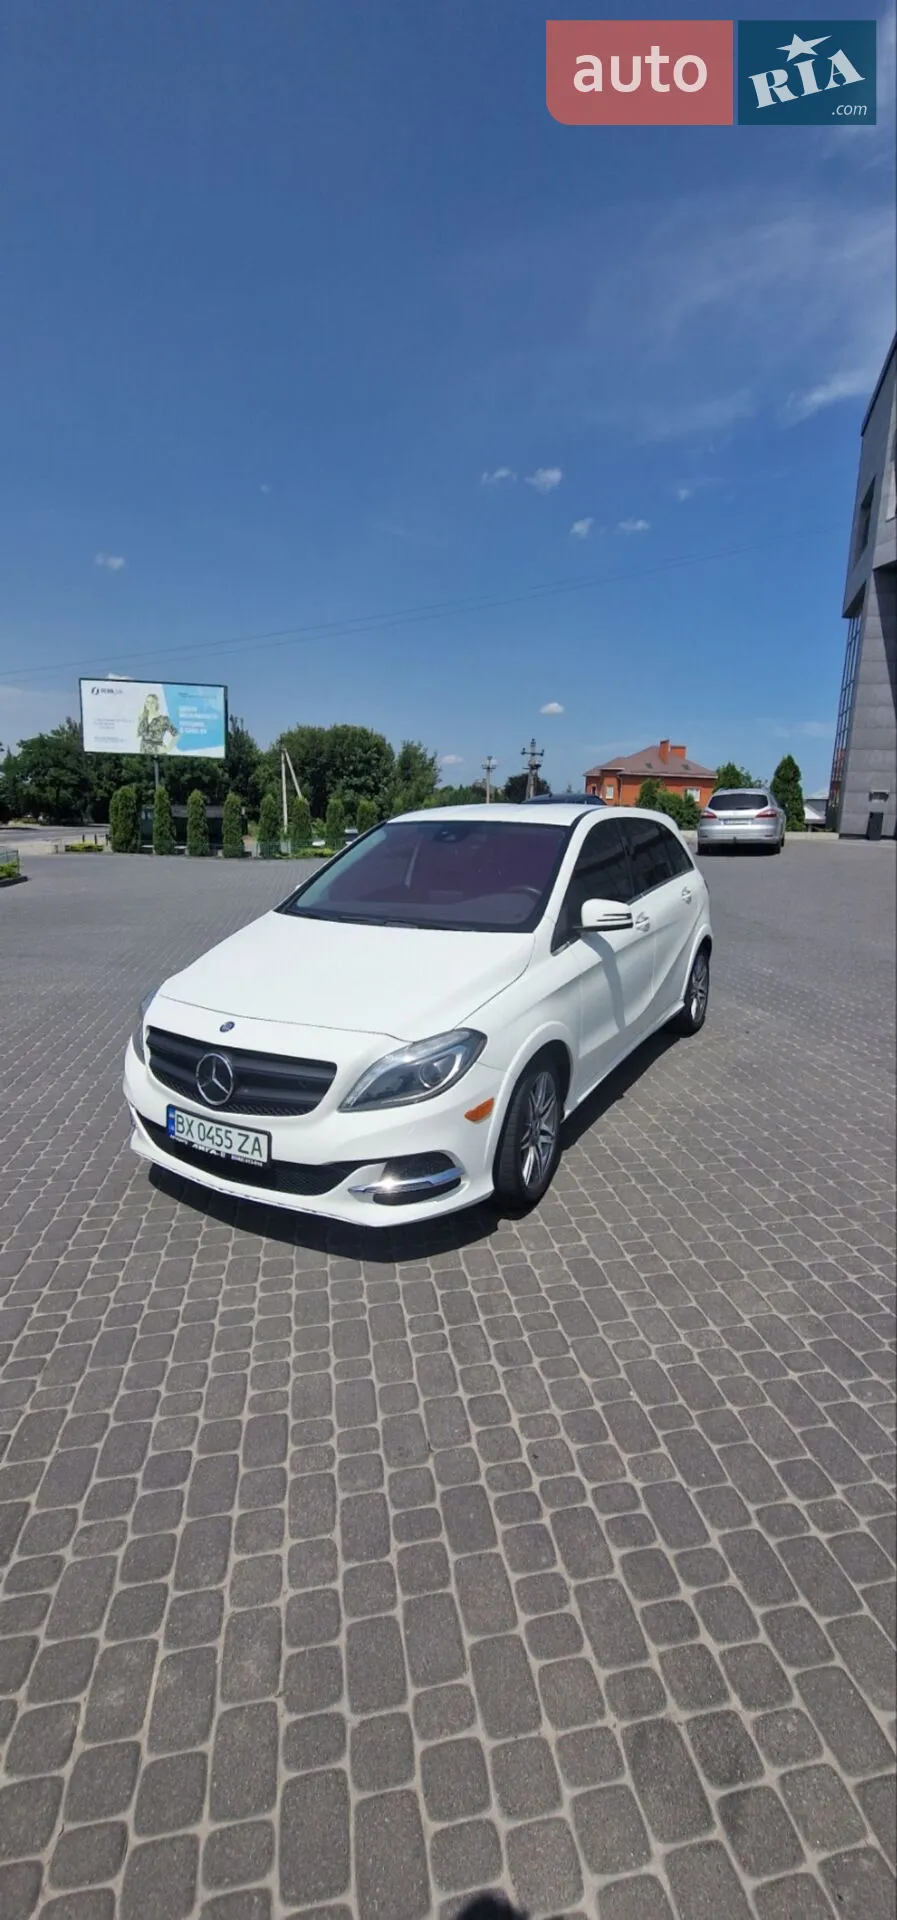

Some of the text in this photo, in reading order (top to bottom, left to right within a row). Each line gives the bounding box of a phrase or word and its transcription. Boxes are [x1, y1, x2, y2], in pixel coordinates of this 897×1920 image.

[176, 1113, 195, 1139] BX
[197, 1122, 233, 1150] 0455
[237, 1132, 263, 1158] ZA
